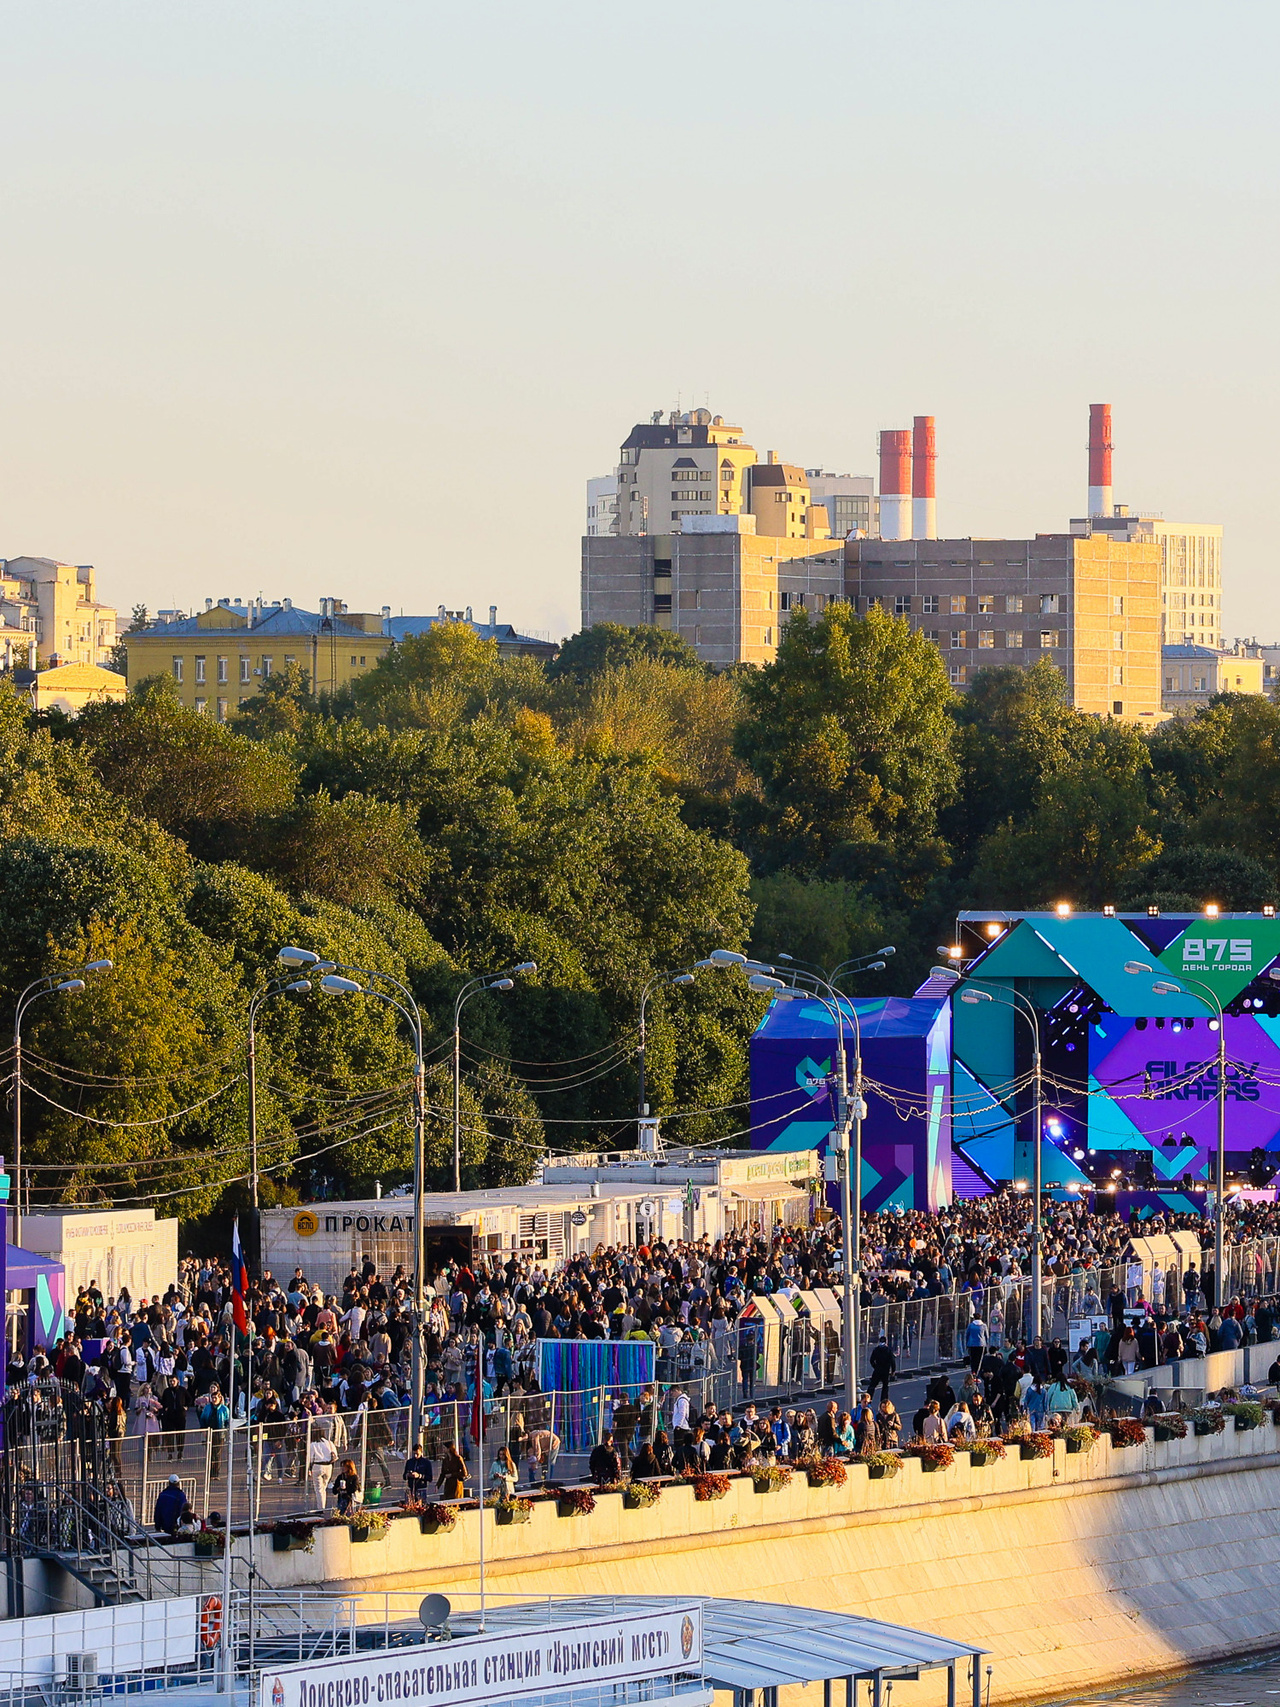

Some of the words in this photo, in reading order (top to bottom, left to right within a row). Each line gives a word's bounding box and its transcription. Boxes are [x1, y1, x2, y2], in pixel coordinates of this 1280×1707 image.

[1182, 938, 1252, 961] 875
[325, 1216, 415, 1233] ПРОКАТ
[300, 1658, 478, 1707] Поисково-спасательная
[483, 1648, 541, 1684] станция
[546, 1629, 624, 1676] «Крымский
[631, 1630, 670, 1662] мост»
